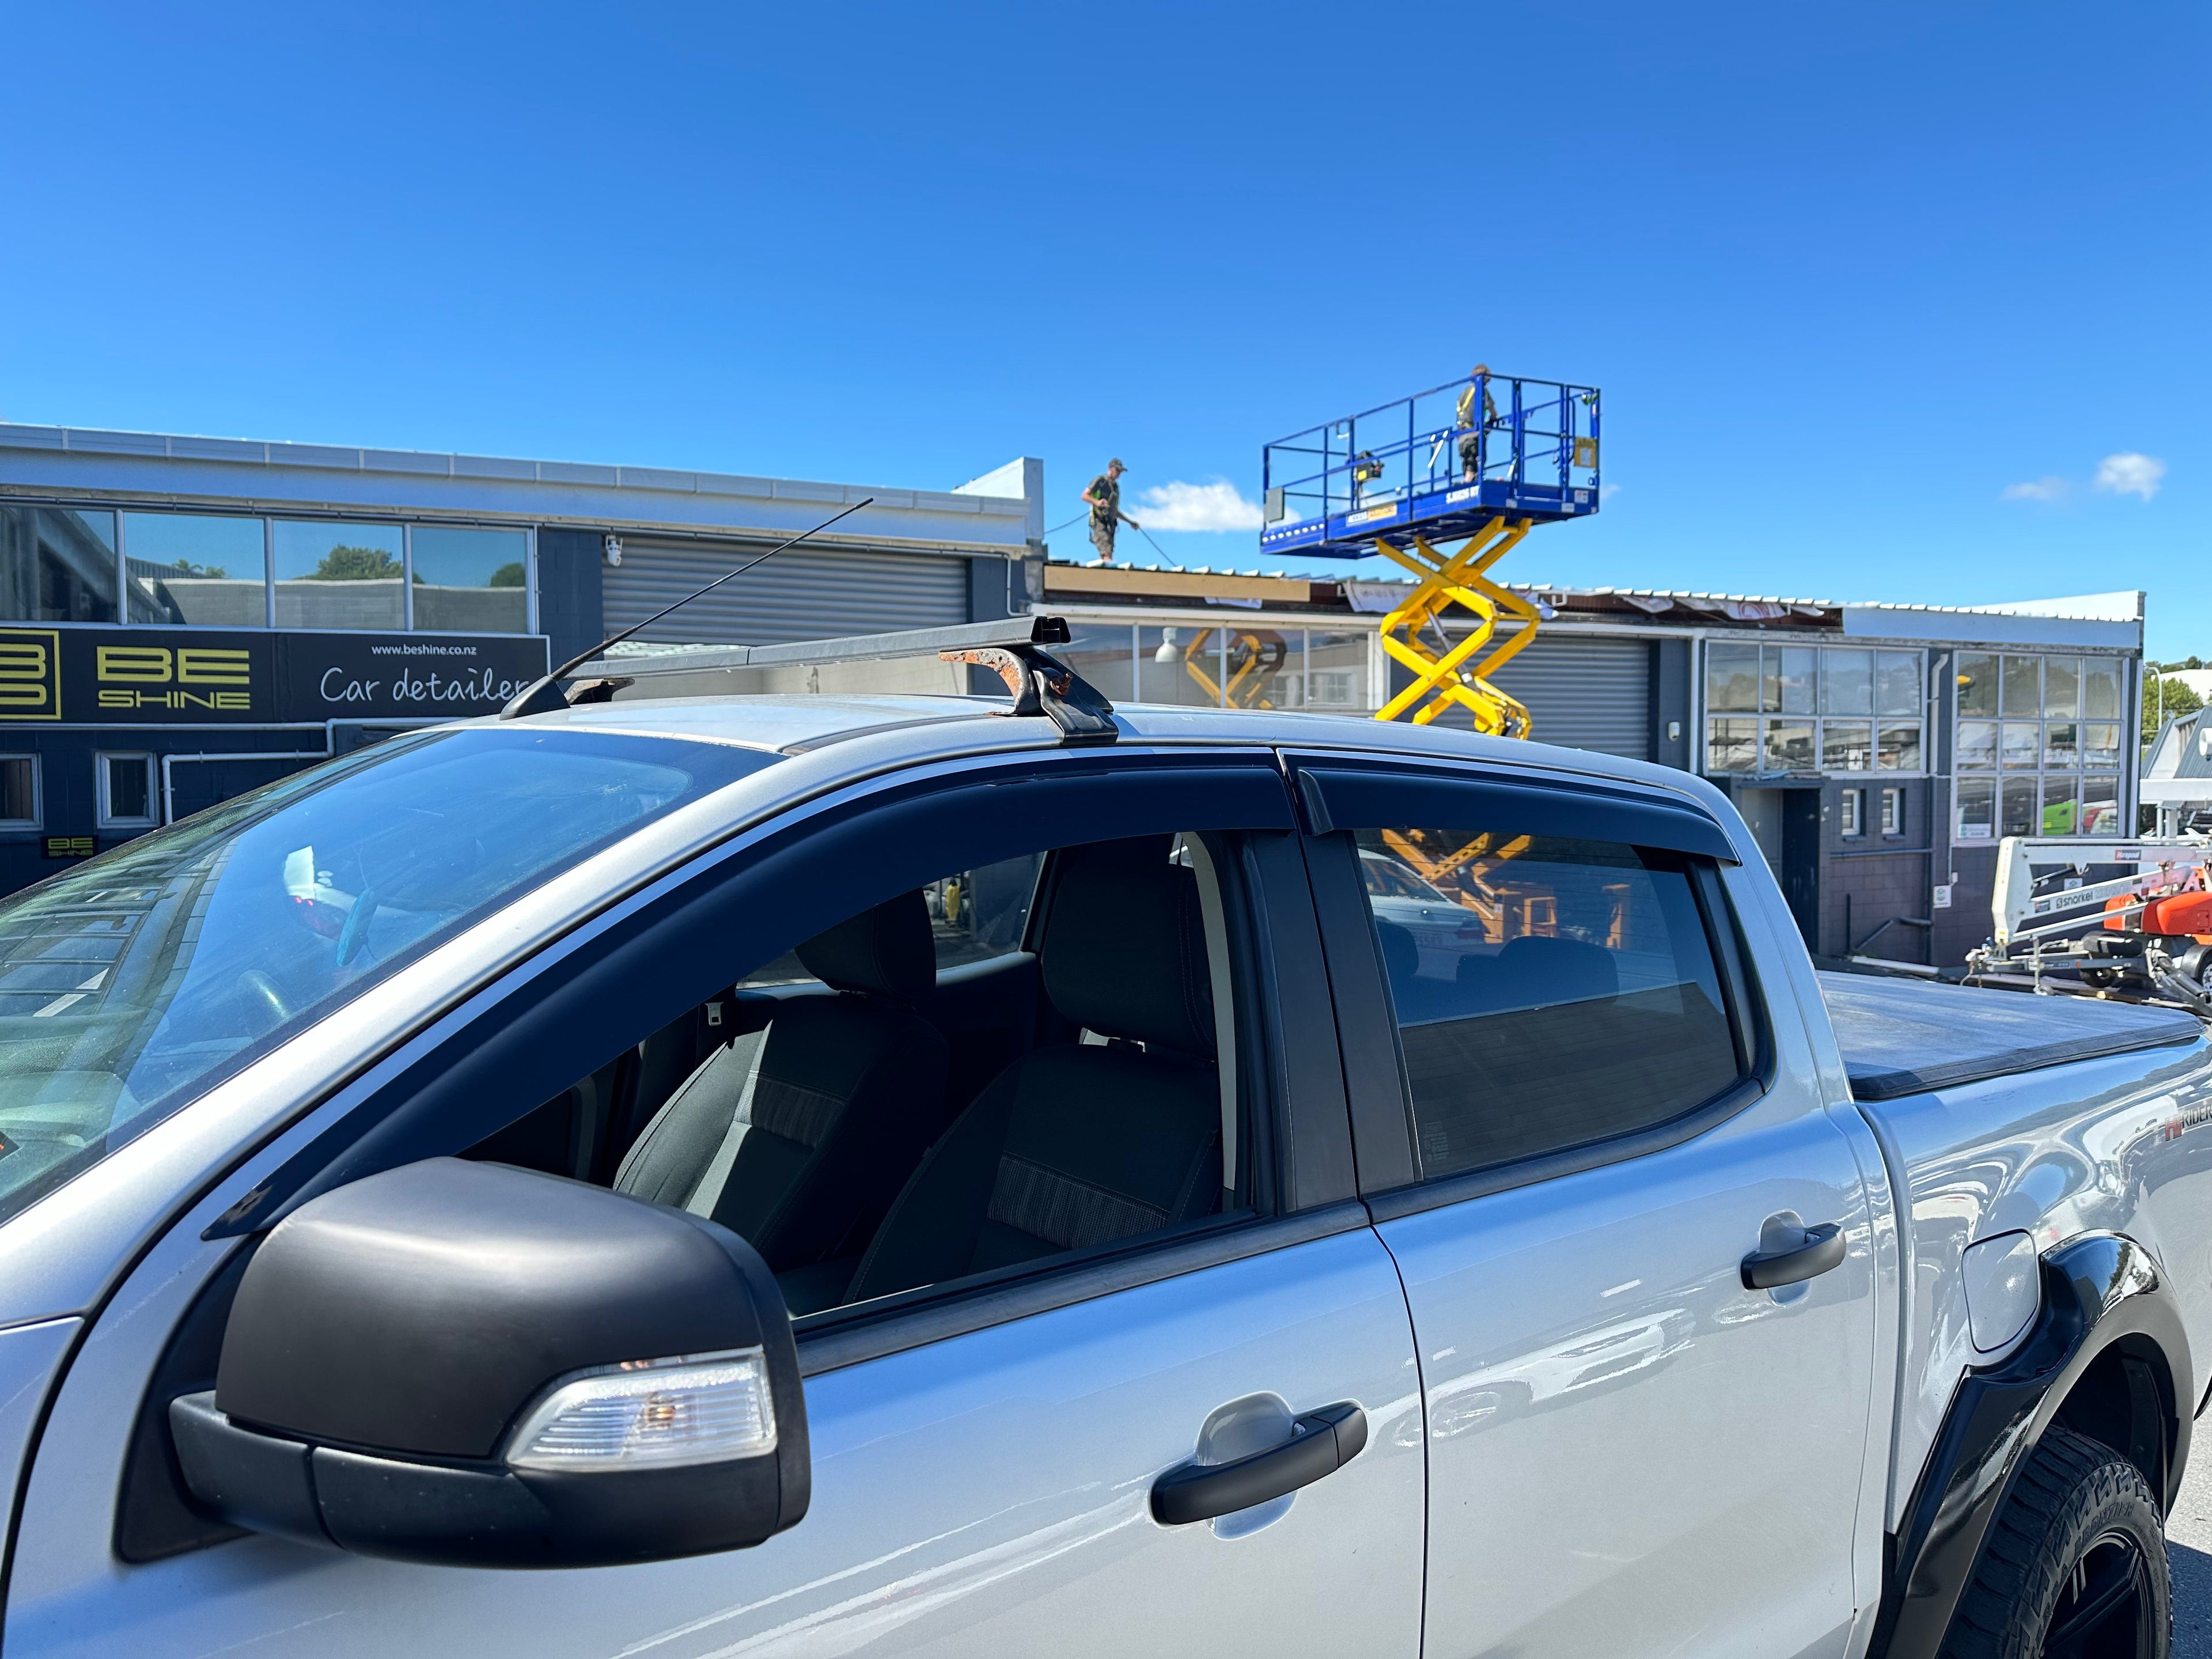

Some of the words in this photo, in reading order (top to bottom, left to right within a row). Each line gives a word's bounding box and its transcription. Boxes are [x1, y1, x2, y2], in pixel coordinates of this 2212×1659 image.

[372, 644, 477, 655] www.beshine.co.nz
[97, 646, 250, 684] BE
[320, 667, 380, 702] Car
[98, 690, 251, 709] SHINE
[48, 837, 93, 849] BE
[48, 849, 93, 857] SHINE
[2063, 891, 2093, 906] snorkel
